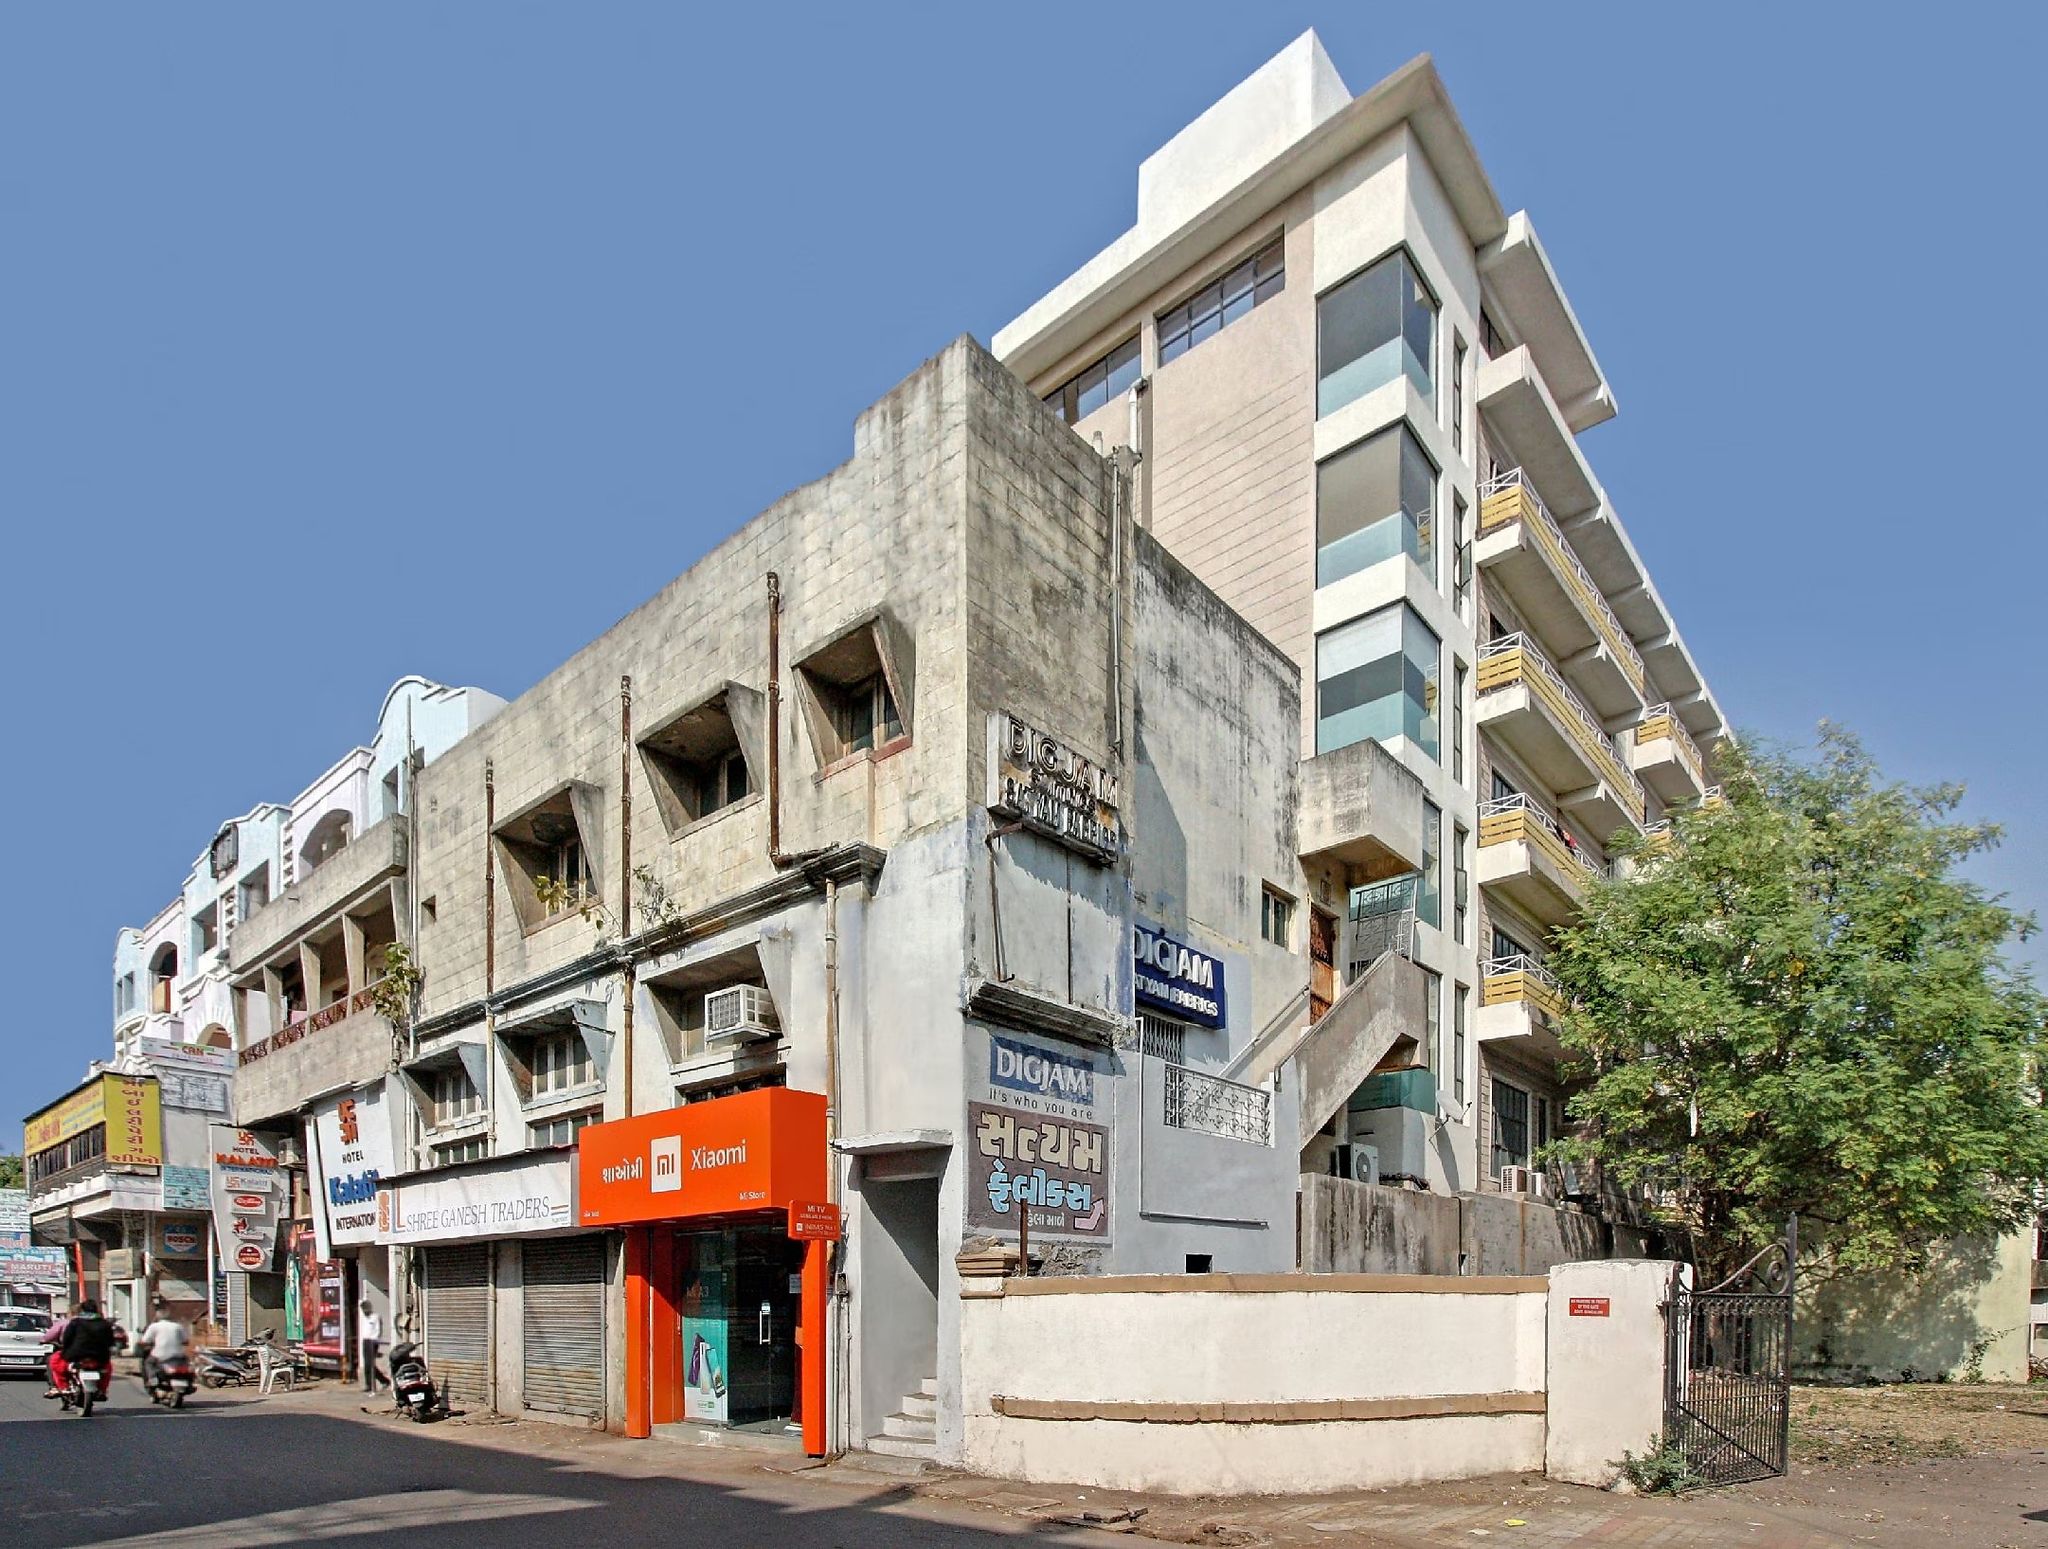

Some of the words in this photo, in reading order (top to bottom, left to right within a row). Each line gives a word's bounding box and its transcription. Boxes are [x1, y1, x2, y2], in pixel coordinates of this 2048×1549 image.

[1008, 716, 1118, 808] DIGJAM
[1134, 973, 1169, 999] ATYAM
[996, 1045, 1087, 1096] DIGJAM
[1014, 1095, 1038, 1109] who
[1044, 1102, 1065, 1115] you
[1071, 1108, 1092, 1120] are
[232, 1146, 260, 1155] HOTEL
[342, 1150, 364, 1164] HOTEL
[691, 1138, 747, 1171] Xiaomi
[602, 1156, 643, 1184] શાઓમી
[336, 1212, 376, 1231] INTERNATION
[406, 1211, 438, 1232] SHREE
[440, 1204, 487, 1228] GANESH
[491, 1196, 551, 1222] TRADERS
